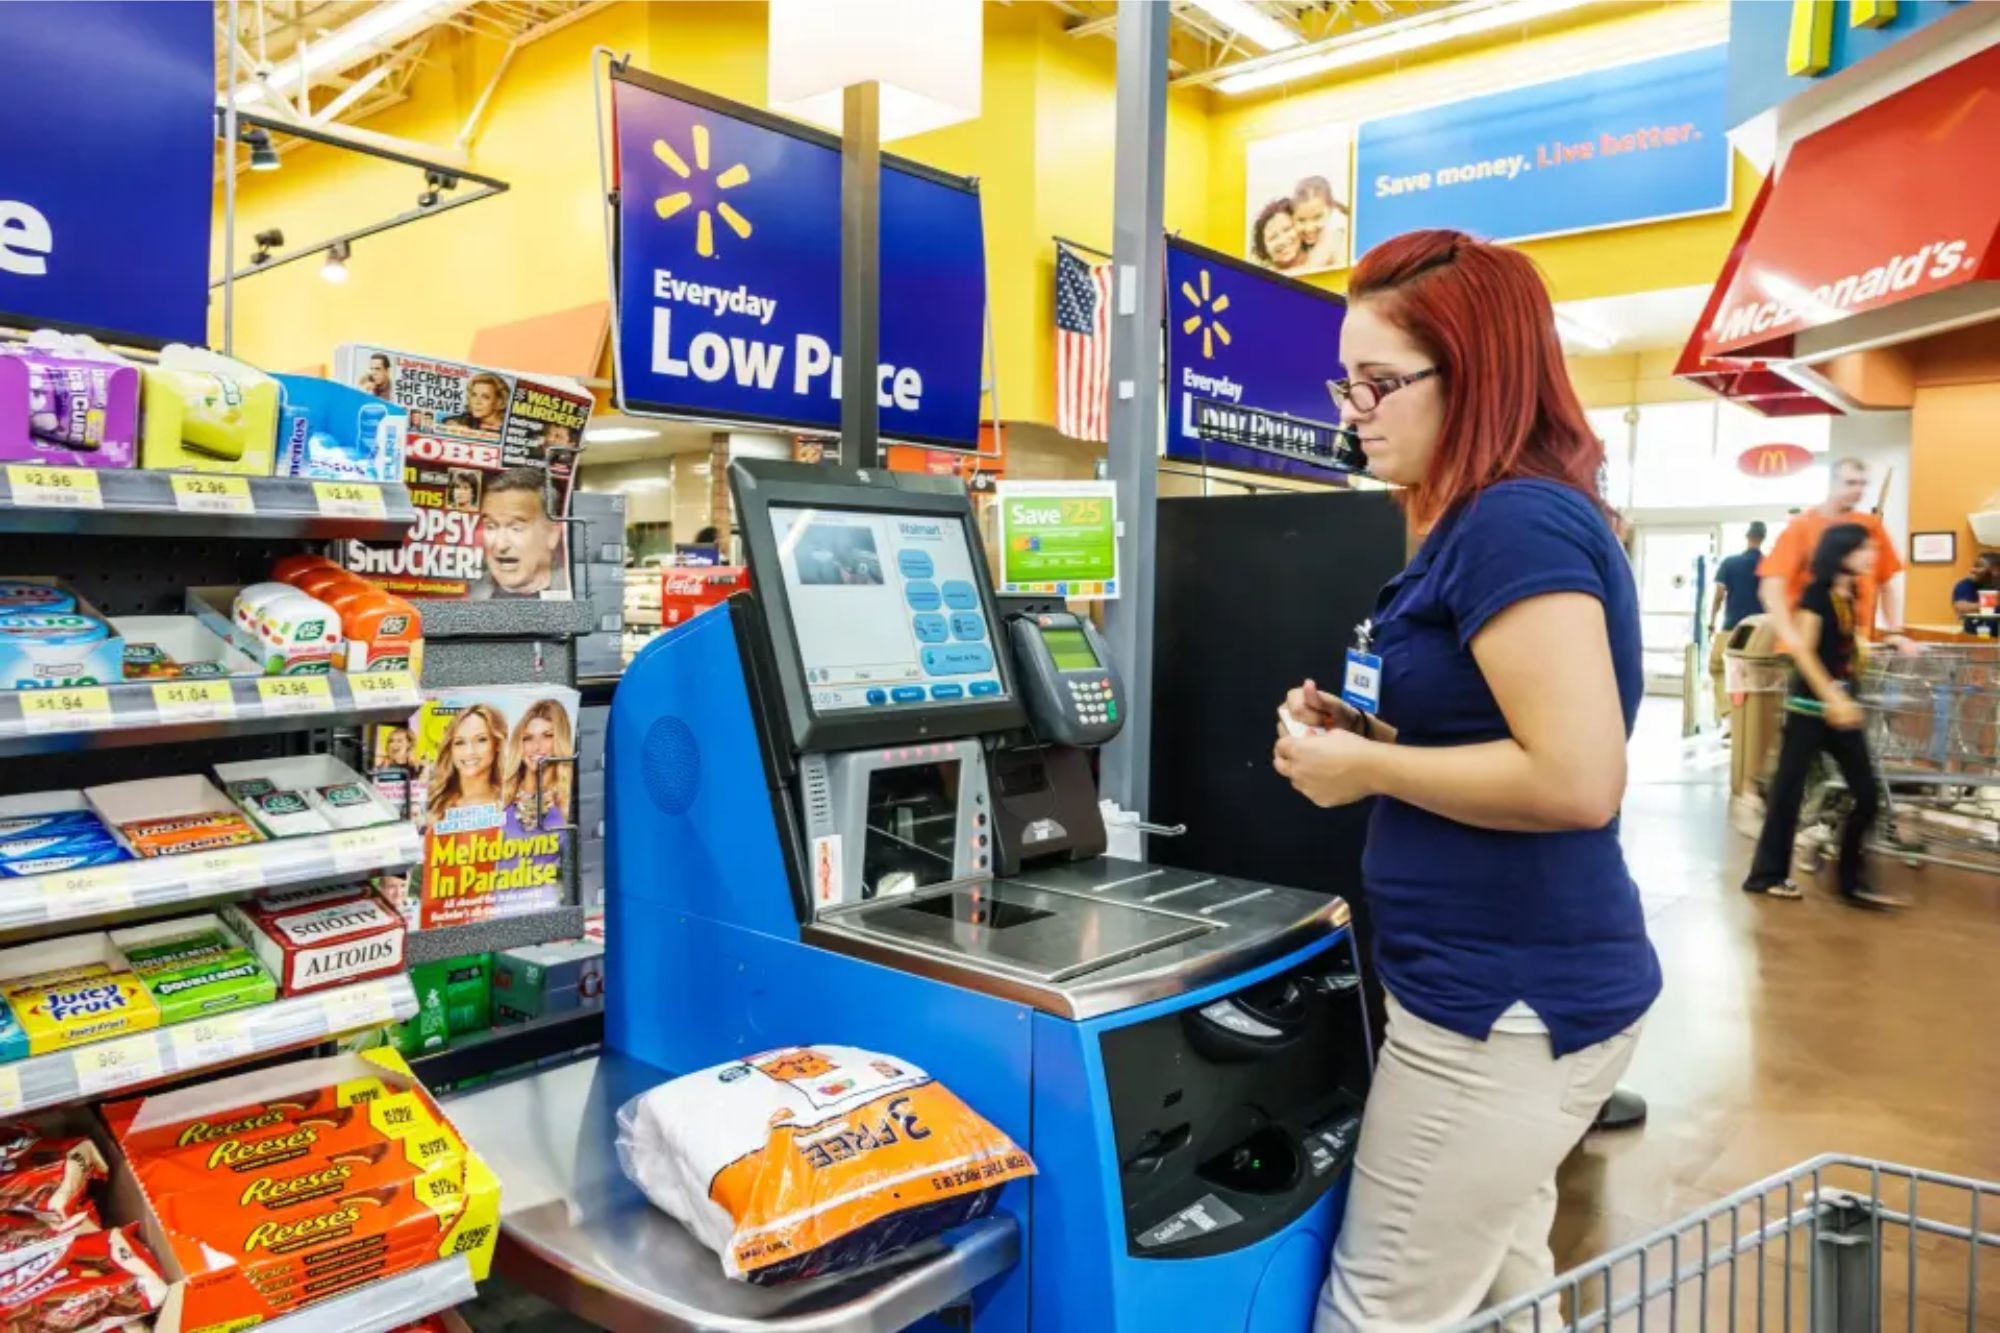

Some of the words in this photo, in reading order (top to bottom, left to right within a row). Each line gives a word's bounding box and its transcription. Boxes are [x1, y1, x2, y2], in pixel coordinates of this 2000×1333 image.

[1375, 172, 1430, 197] Save
[1436, 154, 1532, 186] money.
[1537, 141, 1593, 168] Live
[1599, 122, 1702, 156] better.
[653, 269, 776, 324] Everyday
[651, 306, 784, 389] Low
[395, 379, 422, 394] SHE
[426, 385, 464, 401] TOOK
[401, 368, 460, 389] SECRETS
[1183, 367, 1243, 403] Everyday
[395, 392, 413, 406] TO
[416, 396, 462, 413] GRAVE
[512, 400, 585, 428] MURDER?
[528, 390, 560, 410] WAS
[561, 400, 578, 414] IT
[25, 473, 72, 487] $2.96
[1011, 504, 1062, 525] Save
[36, 696, 83, 711] $1.94
[168, 689, 209, 702] $1.04
[272, 682, 309, 696] $2.96
[431, 829, 561, 867] Meltdowns
[431, 867, 456, 898] In
[459, 858, 558, 895] Paradise
[291, 908, 377, 937] ALTOIDS
[304, 938, 394, 977] ALTOIDS
[159, 965, 254, 995] DOUBLEMINT
[42, 984, 118, 1009] Juicy
[51, 995, 126, 1020] Fruit
[177, 1109, 283, 1147] Reese's
[888, 1097, 931, 1140] 3
[207, 1126, 317, 1169] Reese's
[801, 1118, 898, 1169] FREE
[240, 1164, 351, 1207] Reese's
[243, 1206, 361, 1252] Reese's
